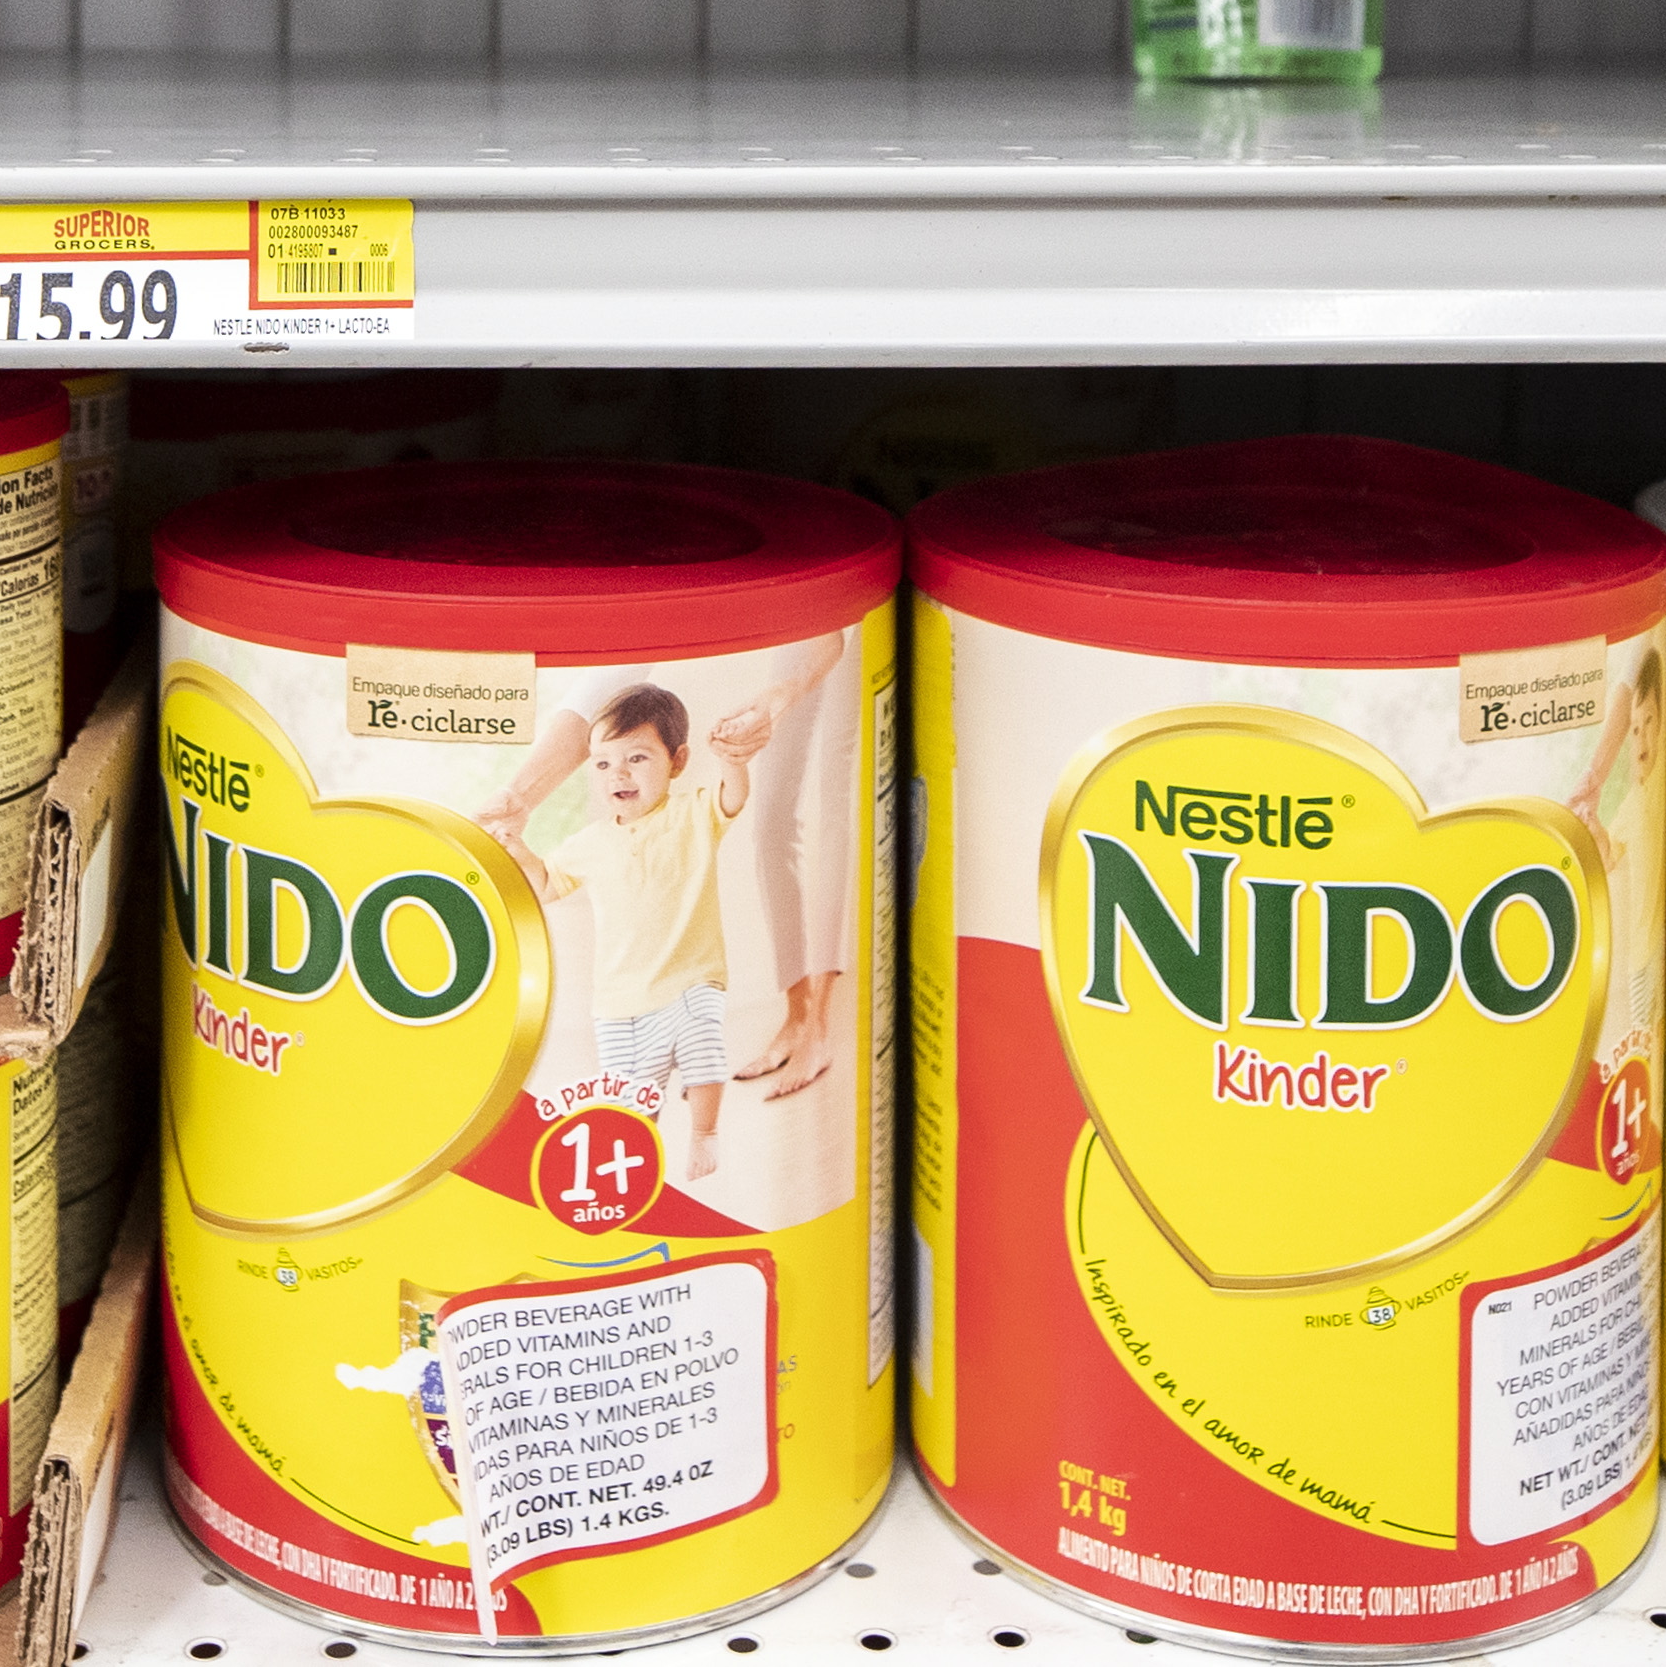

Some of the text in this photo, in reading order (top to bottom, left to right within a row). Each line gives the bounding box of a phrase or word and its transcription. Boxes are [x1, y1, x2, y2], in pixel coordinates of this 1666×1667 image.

[54, 209, 150, 238] SUPERIOR
[268, 225, 358, 239] 002800093487
[213, 319, 252, 335] NESTLE
[255, 319, 280, 335] NIDO
[282, 319, 320, 334] KINDER
[352, 676, 529, 702] Empaque diseñado para
[1135, 779, 1333, 849] Nestlé
[1081, 831, 1579, 1031] NIDO
[194, 979, 289, 1073] Kinder
[1214, 1043, 1387, 1109] Kinder
[559, 1123, 644, 1202] 1+
[573, 1202, 625, 1223] años
[1155, 1370, 1177, 1398] en
[1184, 1396, 1202, 1416] el
[1207, 1416, 1263, 1465] amor
[1268, 1459, 1297, 1487] de
[1301, 1481, 1374, 1523] mamá
[1099, 1500, 1127, 1535] kg
